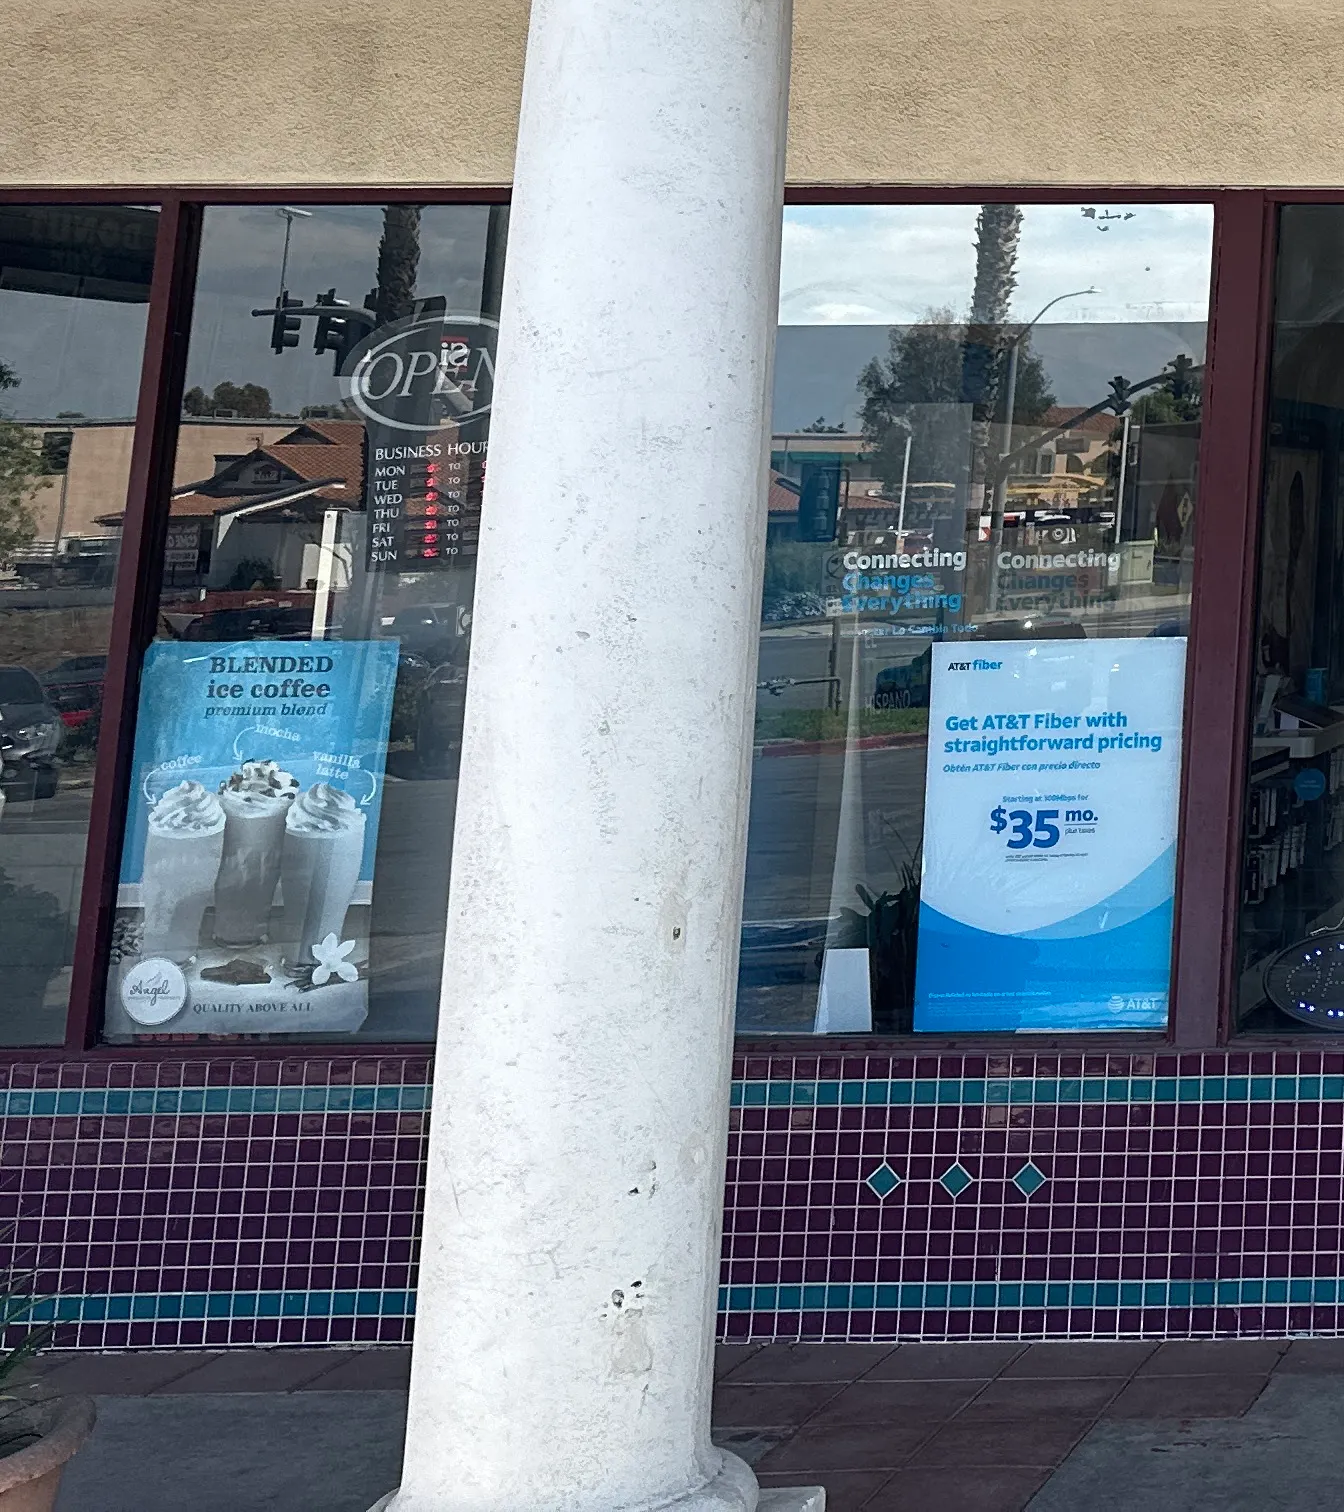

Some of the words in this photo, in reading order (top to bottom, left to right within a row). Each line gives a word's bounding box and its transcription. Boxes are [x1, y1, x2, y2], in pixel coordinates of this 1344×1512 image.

[375, 443, 442, 461] BUSINESS
[447, 440, 489, 456] HOUR
[374, 465, 406, 478] MON
[448, 462, 461, 470] TO
[374, 479, 398, 491] TUE
[448, 476, 461, 484] TO
[373, 493, 403, 505] WED
[447, 490, 460, 499] TO
[373, 507, 400, 520] THU
[447, 504, 460, 513] TO
[372, 521, 391, 534] FRI
[446, 518, 459, 527] TO
[371, 535, 395, 548] SAT
[446, 533, 459, 541] TO
[371, 549, 398, 562] SUN
[445, 547, 459, 555] TO
[842, 548, 967, 572] Connecting
[996, 549, 1122, 571] Connecting
[842, 571, 935, 595] Changes
[841, 590, 963, 615] Everything
[208, 656, 335, 674] BLENDED
[947, 661, 972, 671] AT&T
[973, 658, 1003, 671] fiber
[205, 679, 244, 699] ice
[250, 678, 331, 699] coffee
[203, 703, 276, 719] premium
[279, 702, 328, 716] blend
[945, 715, 979, 731] Get
[981, 714, 1031, 731] AT&T
[1033, 712, 1082, 729] Fiber
[1085, 711, 1128, 728] with
[253, 723, 302, 742] mocha
[943, 733, 1095, 756] straightforward
[1097, 731, 1163, 754] pricing
[160, 753, 203, 772] coffee
[312, 750, 361, 769] vanilla
[997, 762, 1020, 772] Fiber
[1068, 760, 1101, 770] directo
[316, 763, 350, 781] latte
[989, 804, 1061, 850] $35
[1065, 809, 1099, 822] mo.
[129, 979, 171, 1007] Angel
[193, 1002, 243, 1014] QUALITY
[249, 1001, 288, 1013] ABOVE
[1126, 996, 1160, 1010] AT&T
